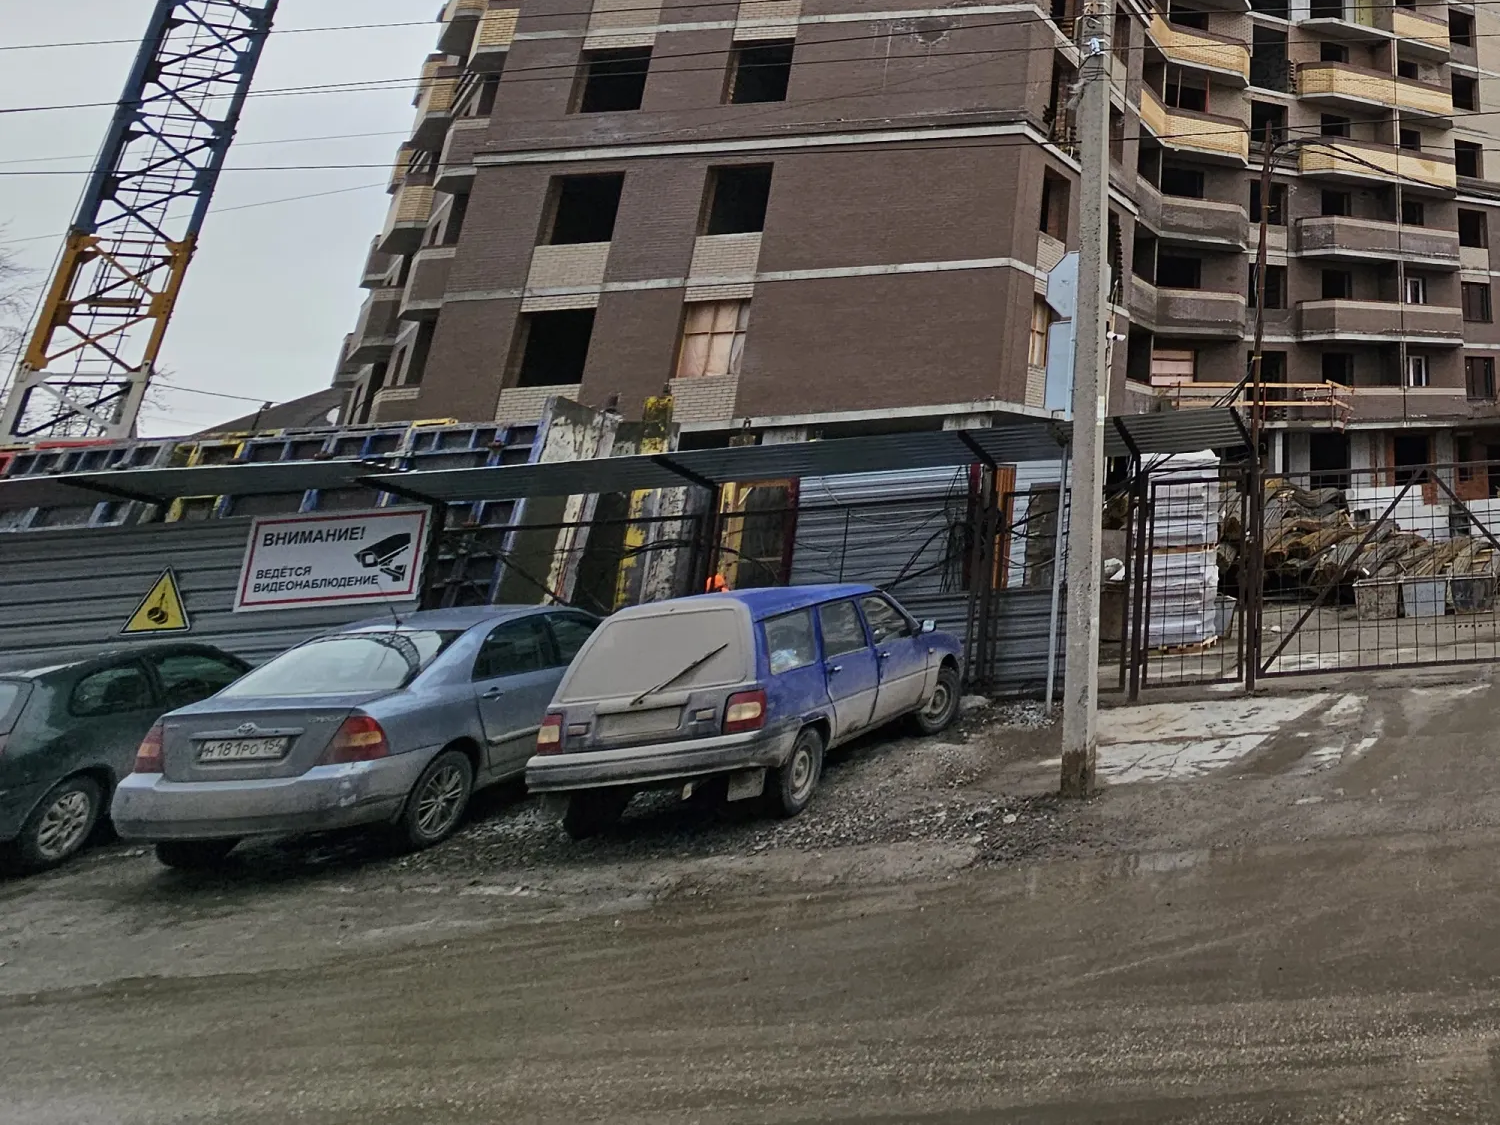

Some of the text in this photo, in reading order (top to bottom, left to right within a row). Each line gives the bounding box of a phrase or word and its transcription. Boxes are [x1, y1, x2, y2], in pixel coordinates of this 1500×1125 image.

[263, 526, 367, 547] ВНИМАНИЕ!
[256, 566, 312, 580] ВЕДЁТСЯ
[253, 574, 379, 593] ВИДЕОНАБЛЮДЕНИЕ
